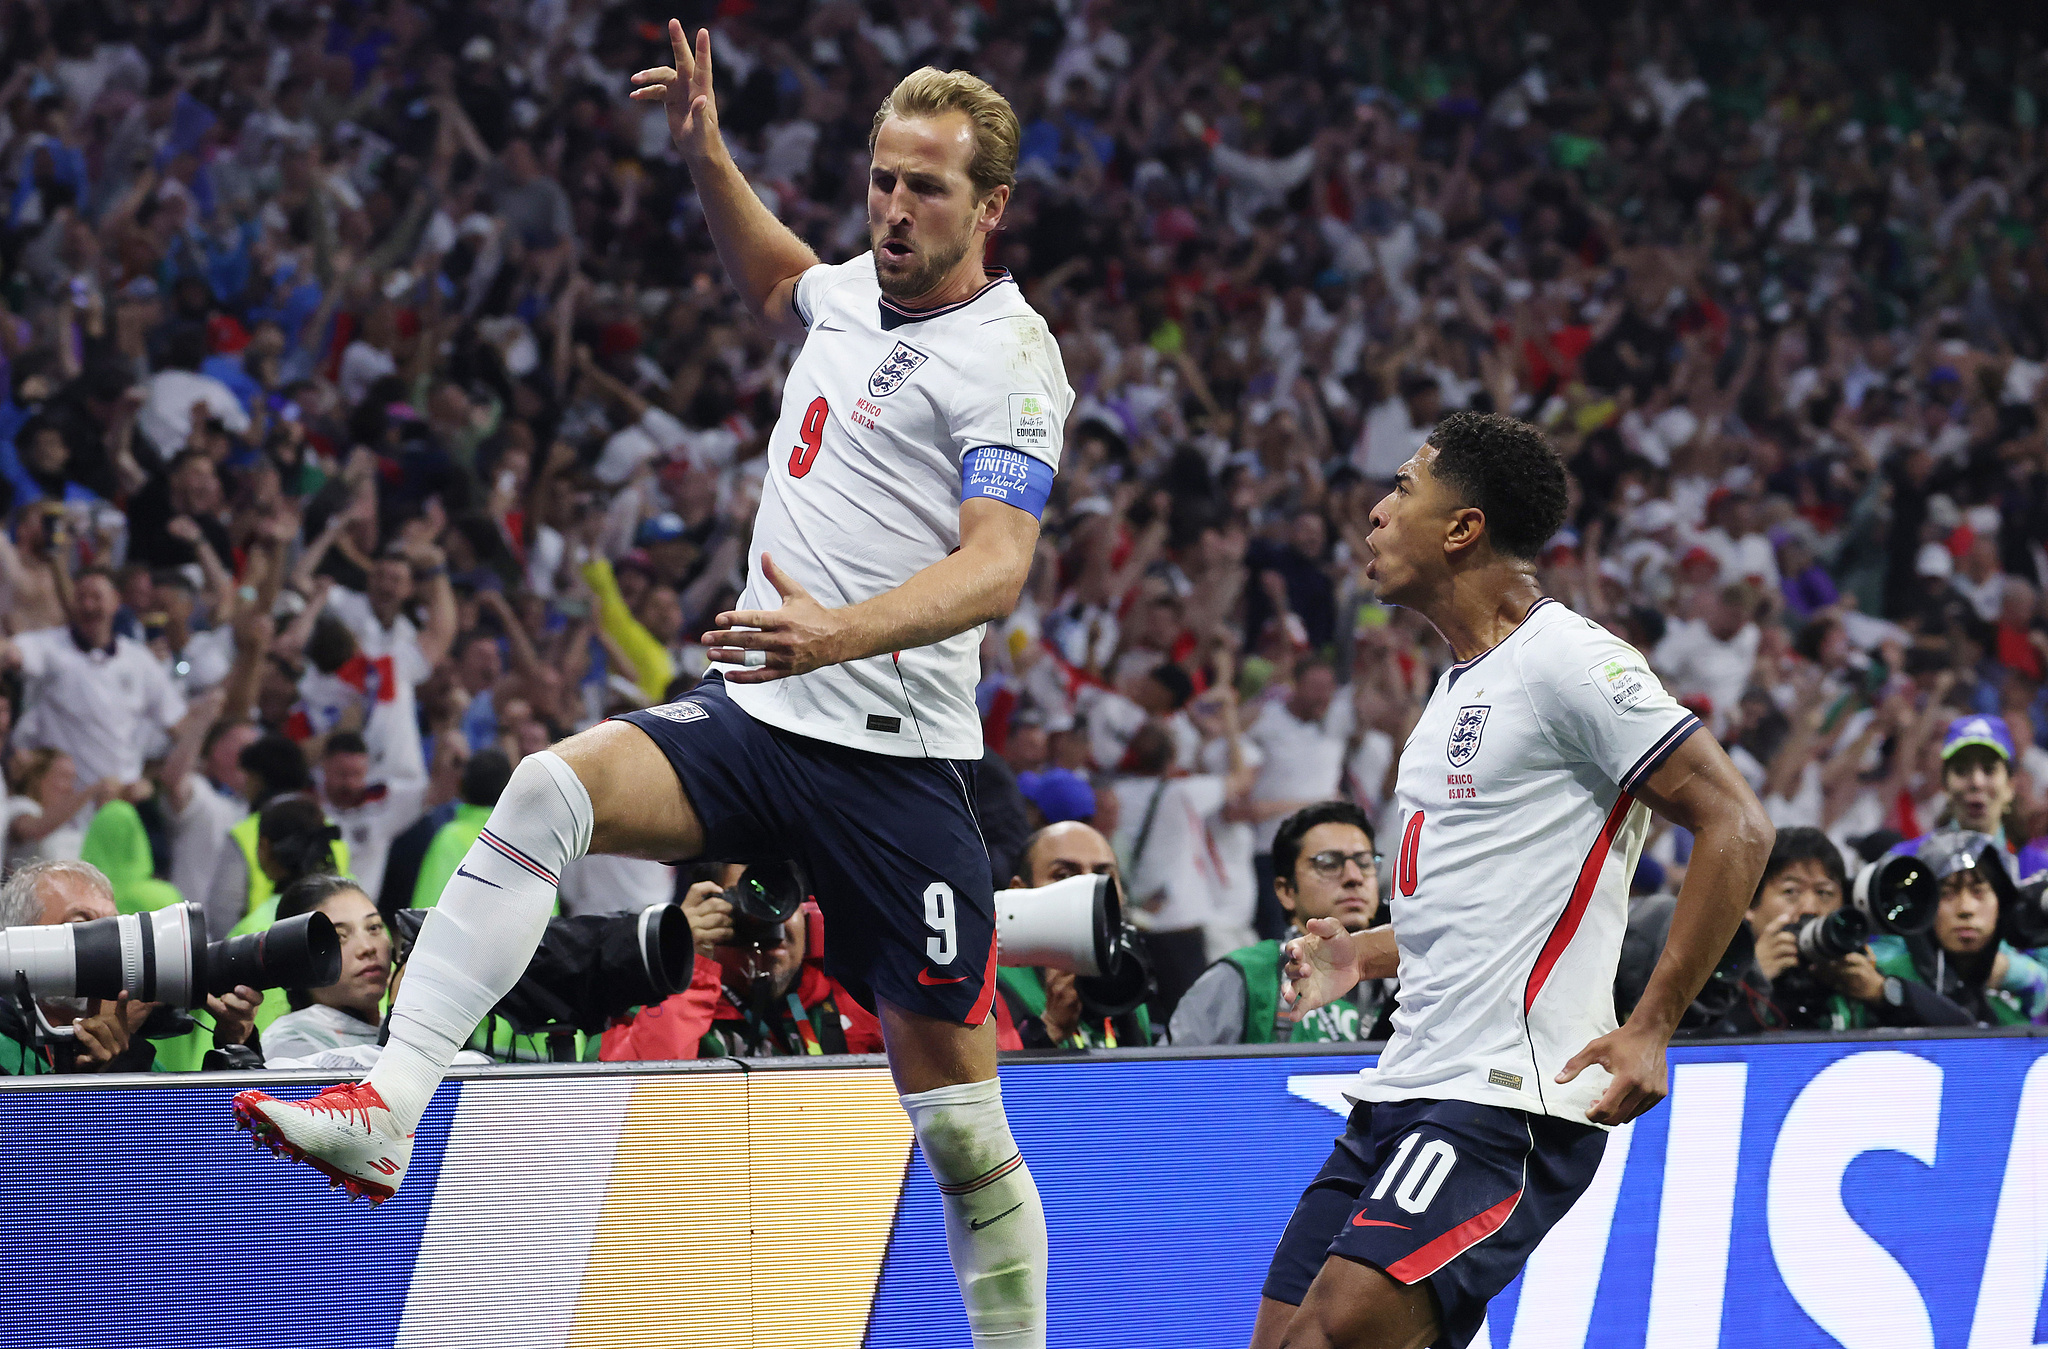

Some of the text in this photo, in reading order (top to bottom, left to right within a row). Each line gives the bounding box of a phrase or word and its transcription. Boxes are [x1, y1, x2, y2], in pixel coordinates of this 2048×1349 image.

[856, 397, 881, 417] MEXICO
[851, 410, 875, 430] 05.07.26
[1020, 416, 1035, 427] Unite
[788, 396, 829, 479] 9
[1016, 428, 1047, 437] EDUCATION
[977, 447, 1029, 466] FOOTBALL
[974, 457, 1029, 479] UNITES
[969, 472, 1028, 494] the World
[985, 487, 1006, 497] FIFA
[1612, 681, 1643, 704] EDUCATION
[1447, 774, 1473, 785] MEXICO
[1449, 787, 1476, 799] 05.07.26
[922, 882, 958, 965] 9
[1369, 1132, 1458, 1215] 10
[1287, 1050, 2048, 1349] IS
